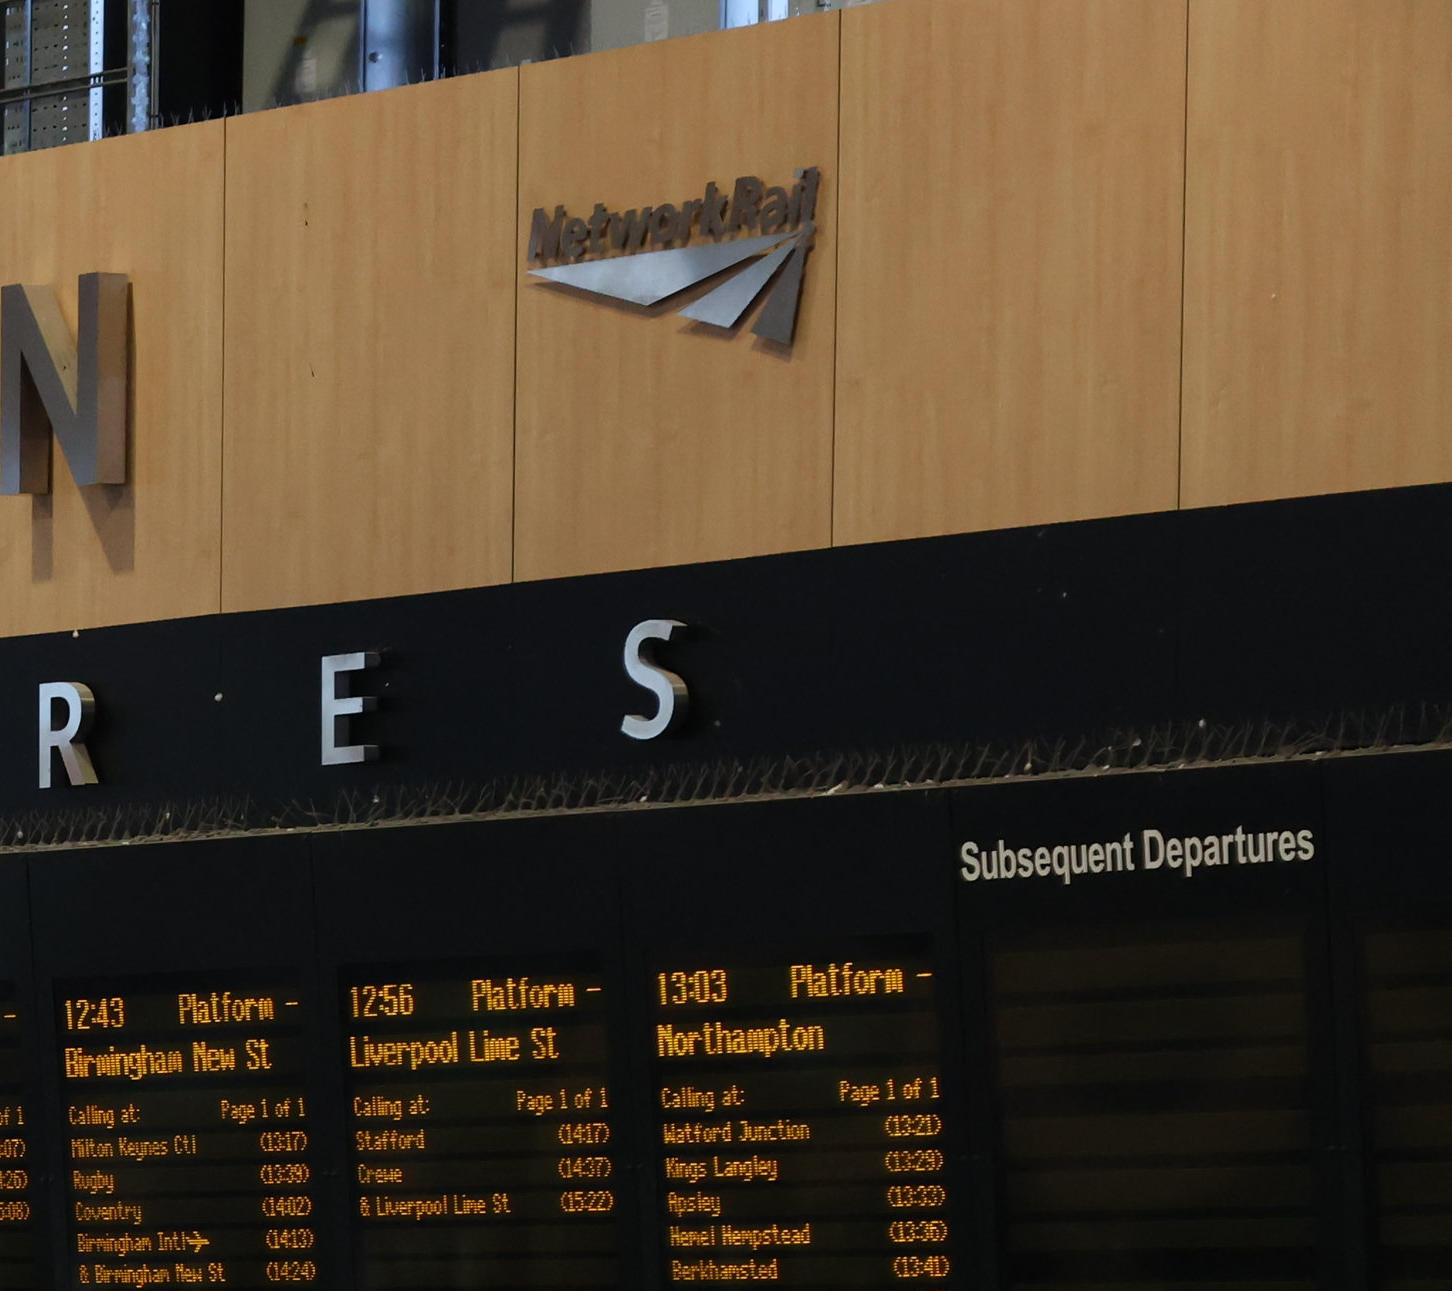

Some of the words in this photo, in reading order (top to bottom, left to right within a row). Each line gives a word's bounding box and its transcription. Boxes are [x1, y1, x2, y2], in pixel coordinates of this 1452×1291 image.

[961, 832, 1135, 884] Subsequent
[1144, 826, 1315, 877] Departures
[351, 984, 414, 1018] 12:56
[472, 977, 574, 1012] Platform
[658, 970, 727, 1006] 13:03
[790, 962, 904, 998] Platform
[65, 998, 124, 1030] 12:43
[179, 992, 273, 1024] Platform
[350, 1032, 458, 1070] Liverpool
[470, 1031, 519, 1063] Lime
[532, 1026, 559, 1060] St
[658, 1018, 824, 1058] Northampton
[65, 1044, 182, 1081] Birmingham
[193, 1043, 235, 1072] New
[246, 1039, 271, 1069] St
[663, 1121, 731, 1144] Watford
[740, 1120, 810, 1141] Junction
[885, 1114, 941, 1136] (13:21)
[672, 1259, 778, 1280] Berkhamsted
